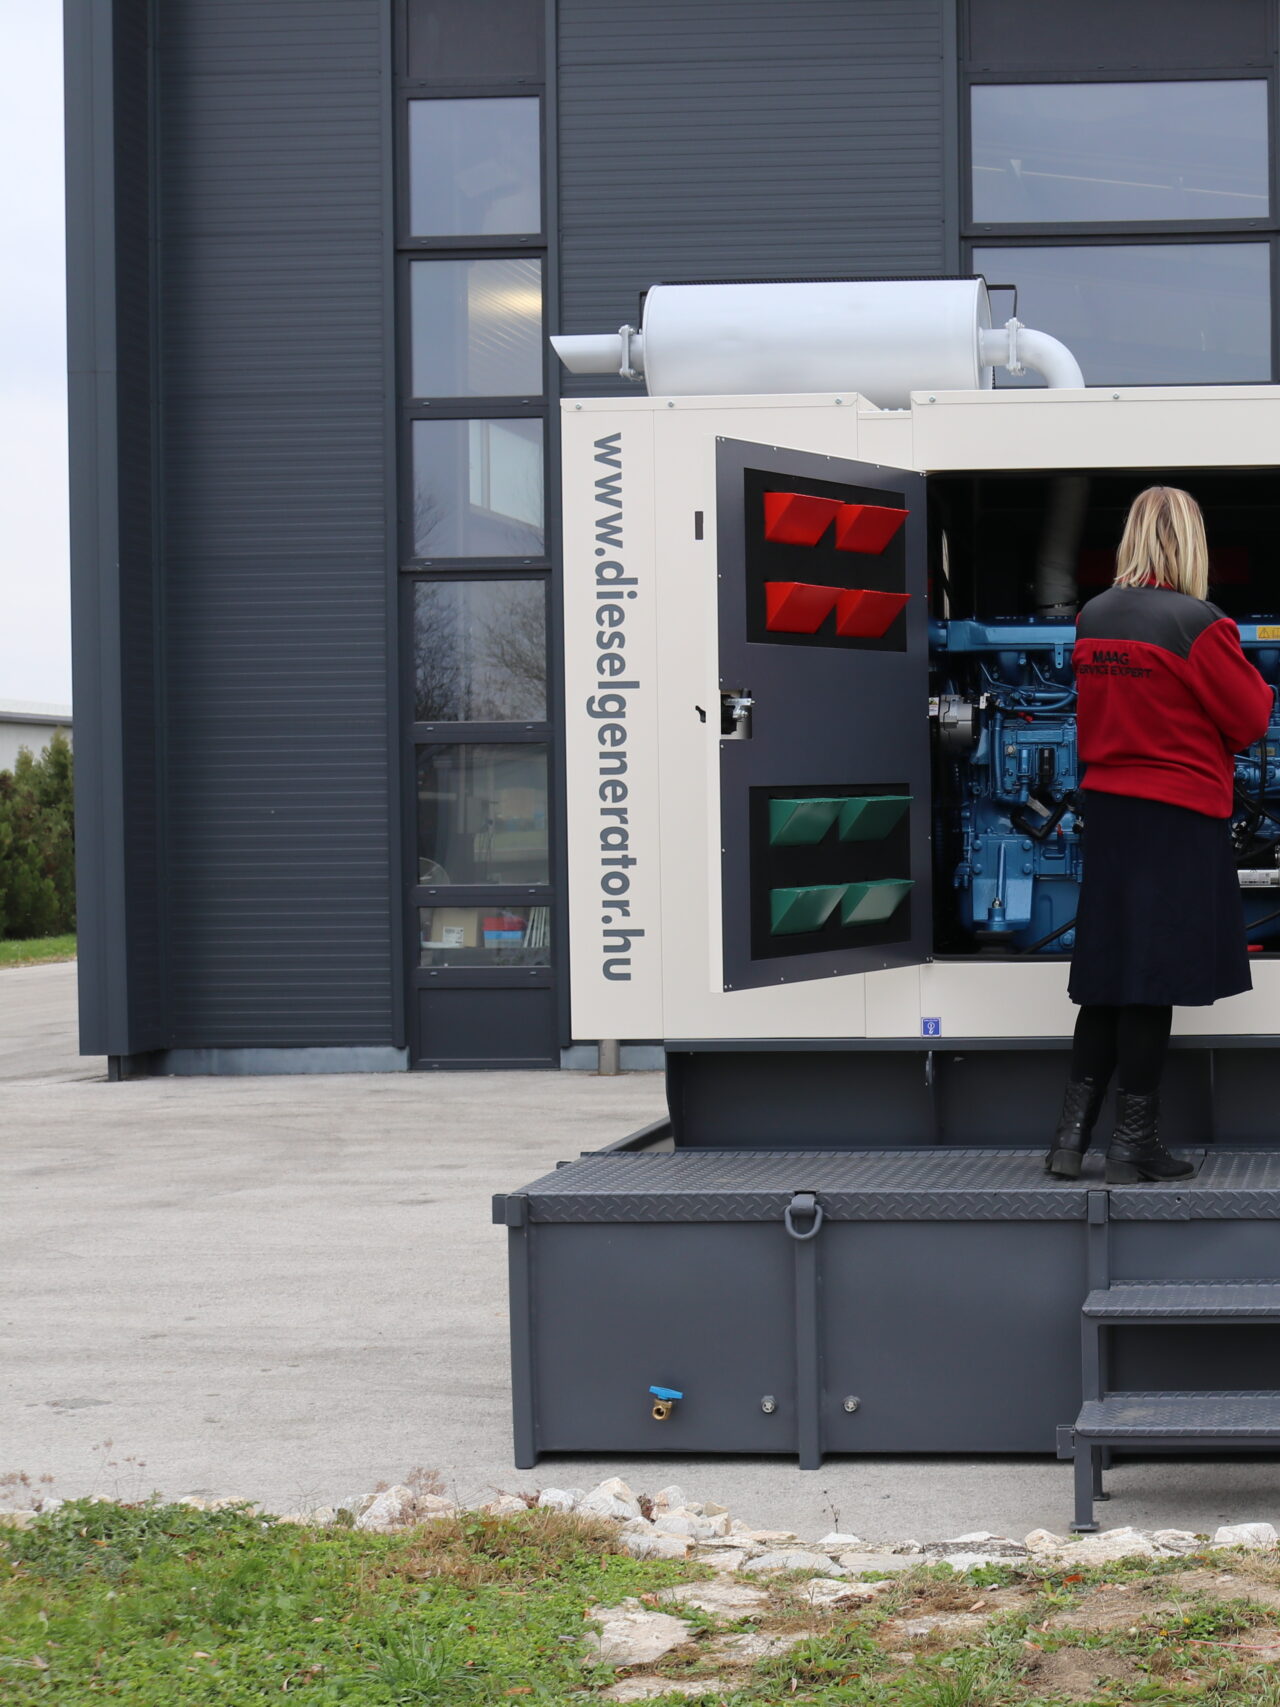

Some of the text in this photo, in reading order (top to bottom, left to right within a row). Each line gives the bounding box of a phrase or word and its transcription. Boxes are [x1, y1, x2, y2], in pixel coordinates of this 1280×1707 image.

[1092, 650, 1129, 665] MAAG
[1110, 665, 1152, 678] EXPERT
[586, 432, 645, 981] www.dieselgenerator.hu
